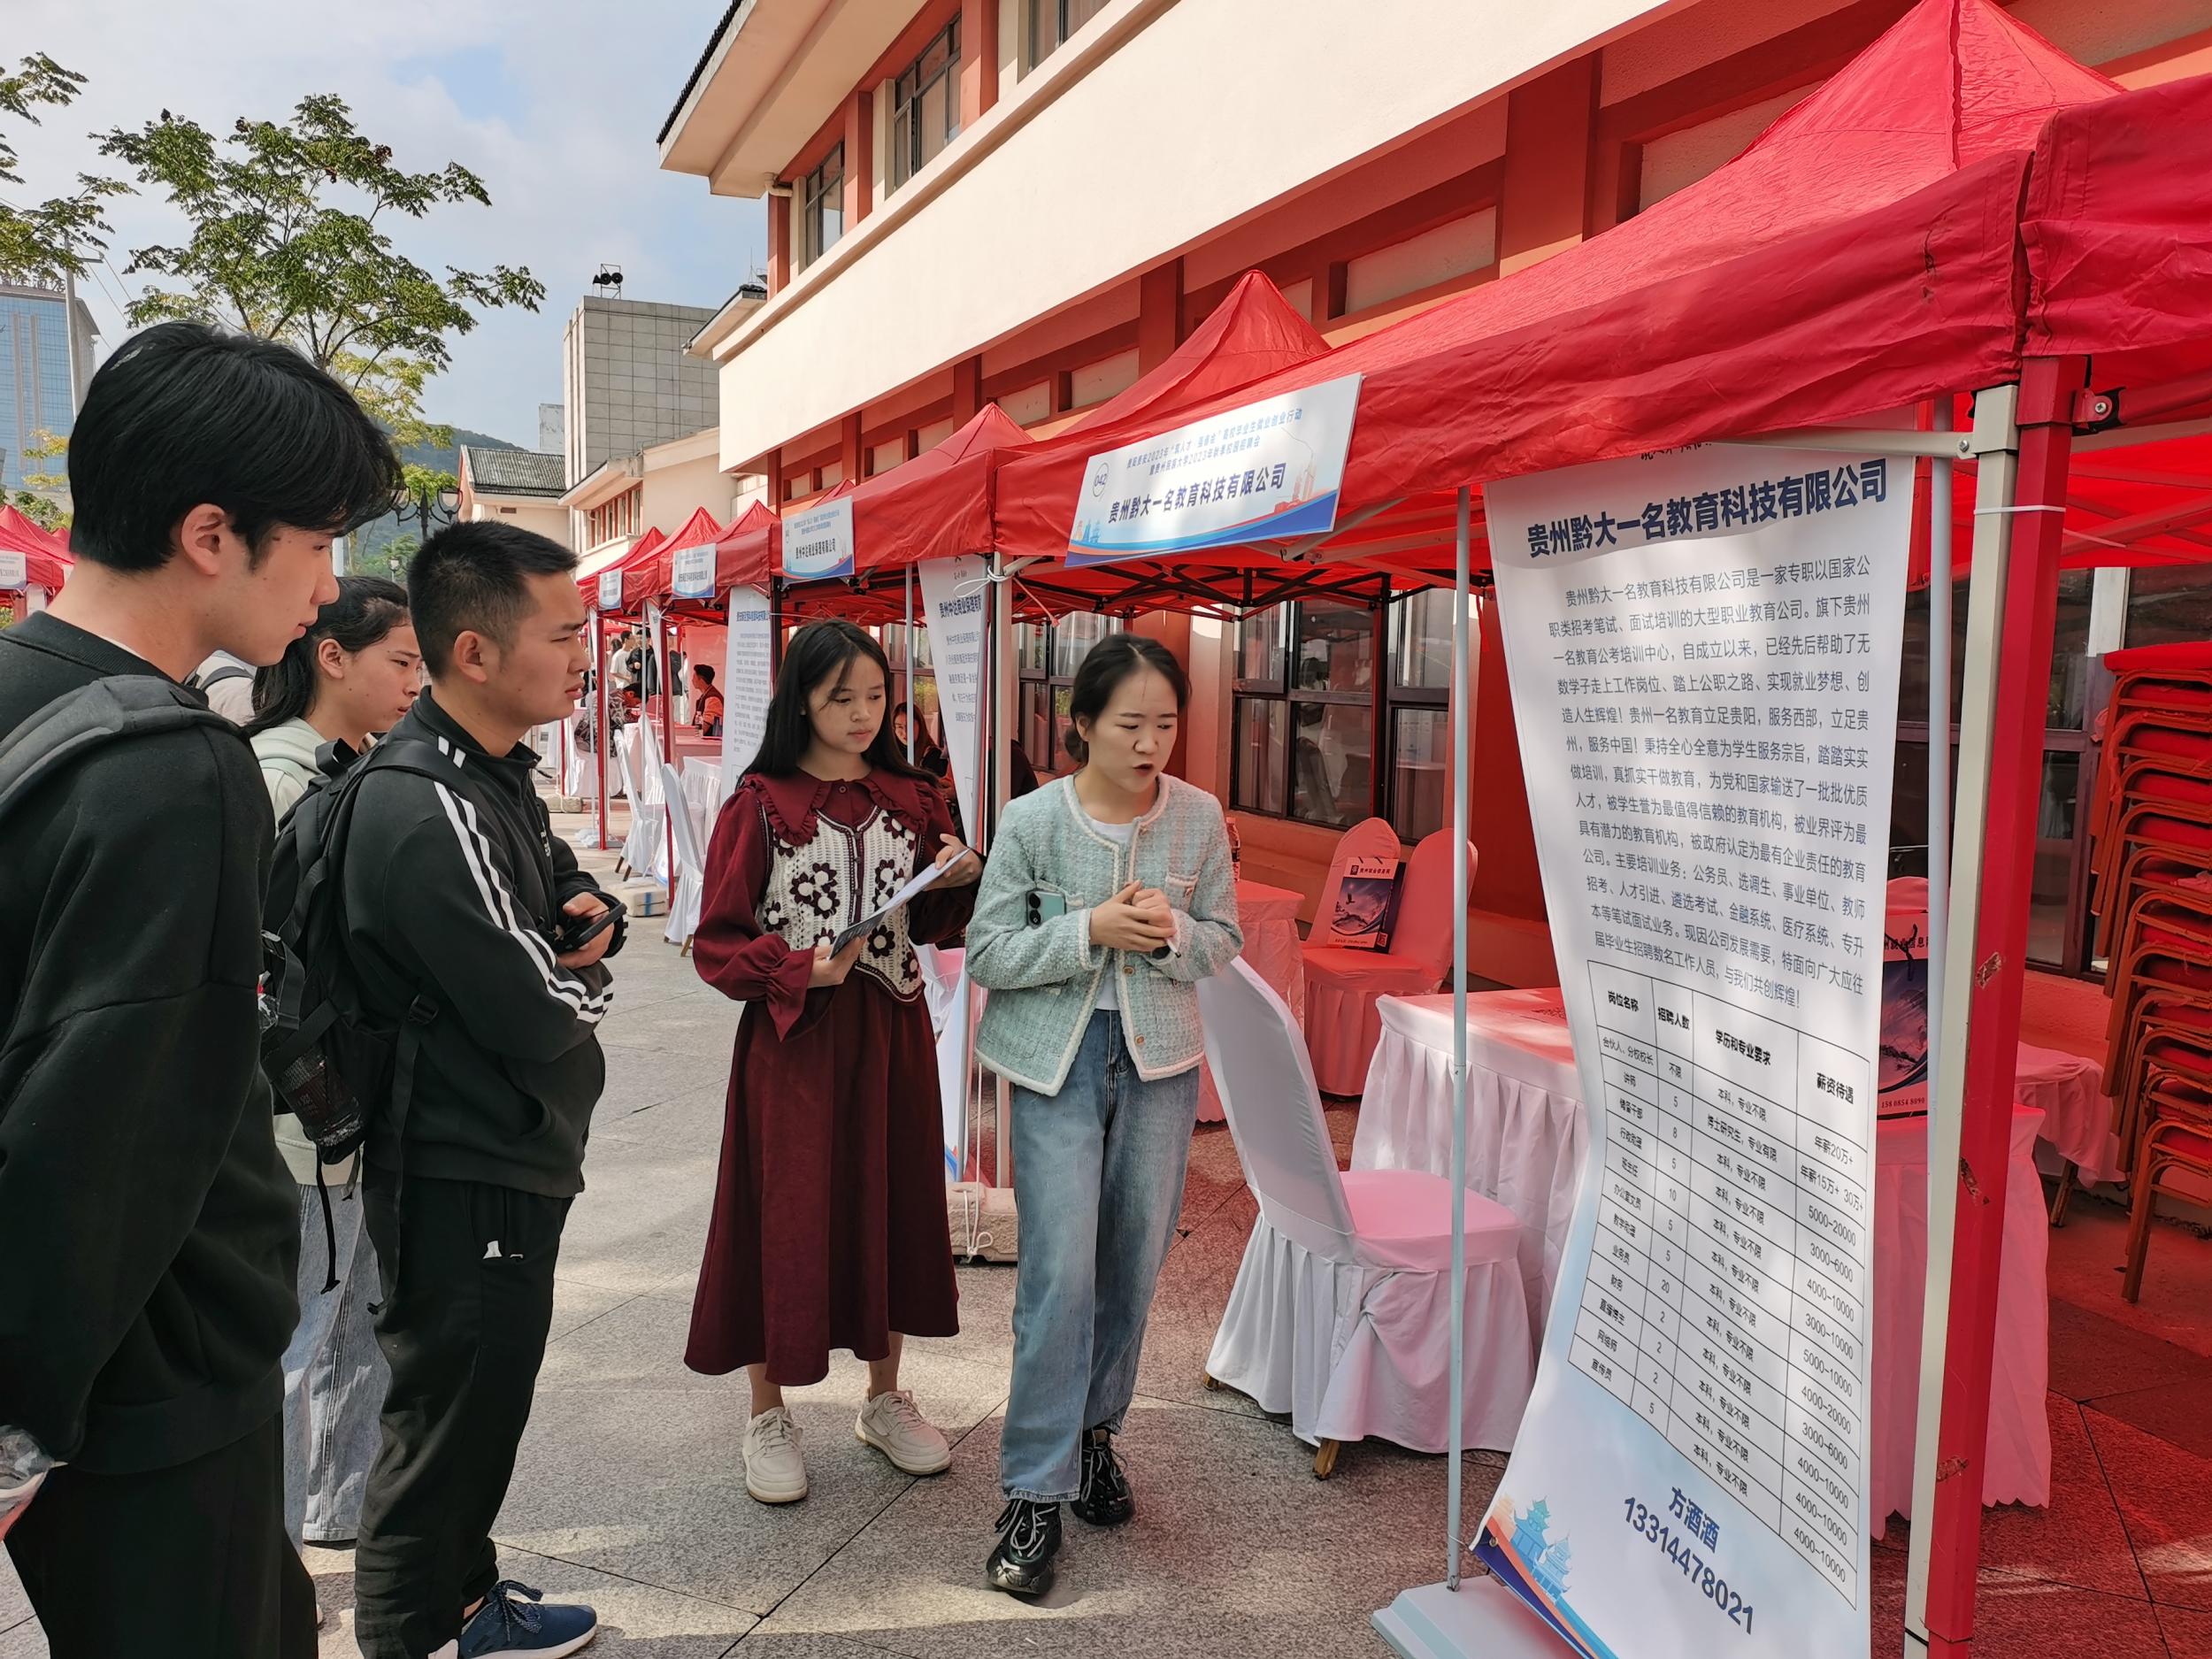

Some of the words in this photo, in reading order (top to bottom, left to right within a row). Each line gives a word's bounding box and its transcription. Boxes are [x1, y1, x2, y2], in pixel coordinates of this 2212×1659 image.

[1094, 473, 1107, 487] 042
[1108, 462, 1286, 524] 贵州黔大一名教育科技有限公司
[1528, 458, 1886, 558] 贵州黔大一名教育科技有限公司
[1565, 555, 1870, 608] 贵州黔大一名教育科技有限公司是一家专职以国家公
[1549, 594, 1870, 638] 职类招考笔试、面试培训的大型职业教育公司。旗下贵州
[1554, 634, 1870, 666] 一名教育公考培训中心，自成立以来，已经先后帮助了无
[1557, 671, 1870, 695] 数学子走上工作岗位、踏上公职之路、实现就业梦想、创
[1562, 707, 1869, 732] 造人生辉煌！贵州一名教育立足贵阳，服务西部，立足贵
[1566, 736, 1869, 768] 州，服务中国！秉持全心全意为学生服务宗旨，踏踏实实
[1571, 764, 1868, 807] 做培训，真抓实干做教育，为党和国家输送了一批批优质
[1576, 793, 1867, 846] 人才，被学生誉为最值得信赖的教育机构，被业界评为最
[1579, 819, 1866, 882] 具有潜力的教育机构，被政府认定为最有企业责任的教育
[1583, 849, 1865, 920] 公司。主要培训业务：公务员、选调生、事业单位、教师
[1586, 876, 1864, 958] 招考、人才引进、遴选考试、金融系统、医疗系统、专升
[1591, 903, 1863, 995] 本等笔试面试业务。现因公司发展需要，特面向广大应往
[1594, 931, 1801, 1009] 届毕业生招聘数名工作人员，与我们共创辉煌！
[1608, 990, 1640, 1012] 岗位名称
[1657, 1006, 1690, 1030] 招聘人数
[1669, 1062, 1682, 1079] 不限
[1716, 1029, 1771, 1066] 学历和专业要求
[1717, 1088, 1767, 1123] 本科，专业不限
[1816, 1072, 1855, 1104] 薪资待遇
[1669, 1187, 1677, 1202] 10
[1717, 1153, 1766, 1192] 本科，专业不限
[1715, 1186, 1764, 1225] 本科，专业不限
[1809, 1205, 1856, 1247] 5000-20000
[1713, 1217, 1762, 1260] 本科，专业不限
[1711, 1250, 1759, 1294] 本科，专业不限
[1810, 1242, 1854, 1283] 3000-6000
[1661, 1279, 1670, 1294] 20
[1709, 1283, 1756, 1328] 本科，专业不限
[1807, 1279, 1855, 1322] 4000-10000
[1707, 1315, 1754, 1363] 本科，专业不限
[1805, 1313, 1854, 1360] 3000-10000
[1702, 1348, 1751, 1395] 本科，专业不限
[1803, 1348, 1852, 1397] 5000-10000
[1699, 1379, 1750, 1430] 本科，专业不限
[1801, 1386, 1851, 1434] 4000-20000
[1695, 1412, 1749, 1463] 本科，专业不限
[1802, 1422, 1847, 1470] 3000-6000
[1694, 1443, 1748, 1497] 本科，专业不限
[1798, 1457, 1849, 1509] 4000-10000
[1669, 1486, 1720, 1554] 方酒酒
[1795, 1493, 1847, 1547] 4000-10000
[1624, 1496, 1754, 1635] 13314478021
[1793, 1527, 1846, 1583] 4000-10000
